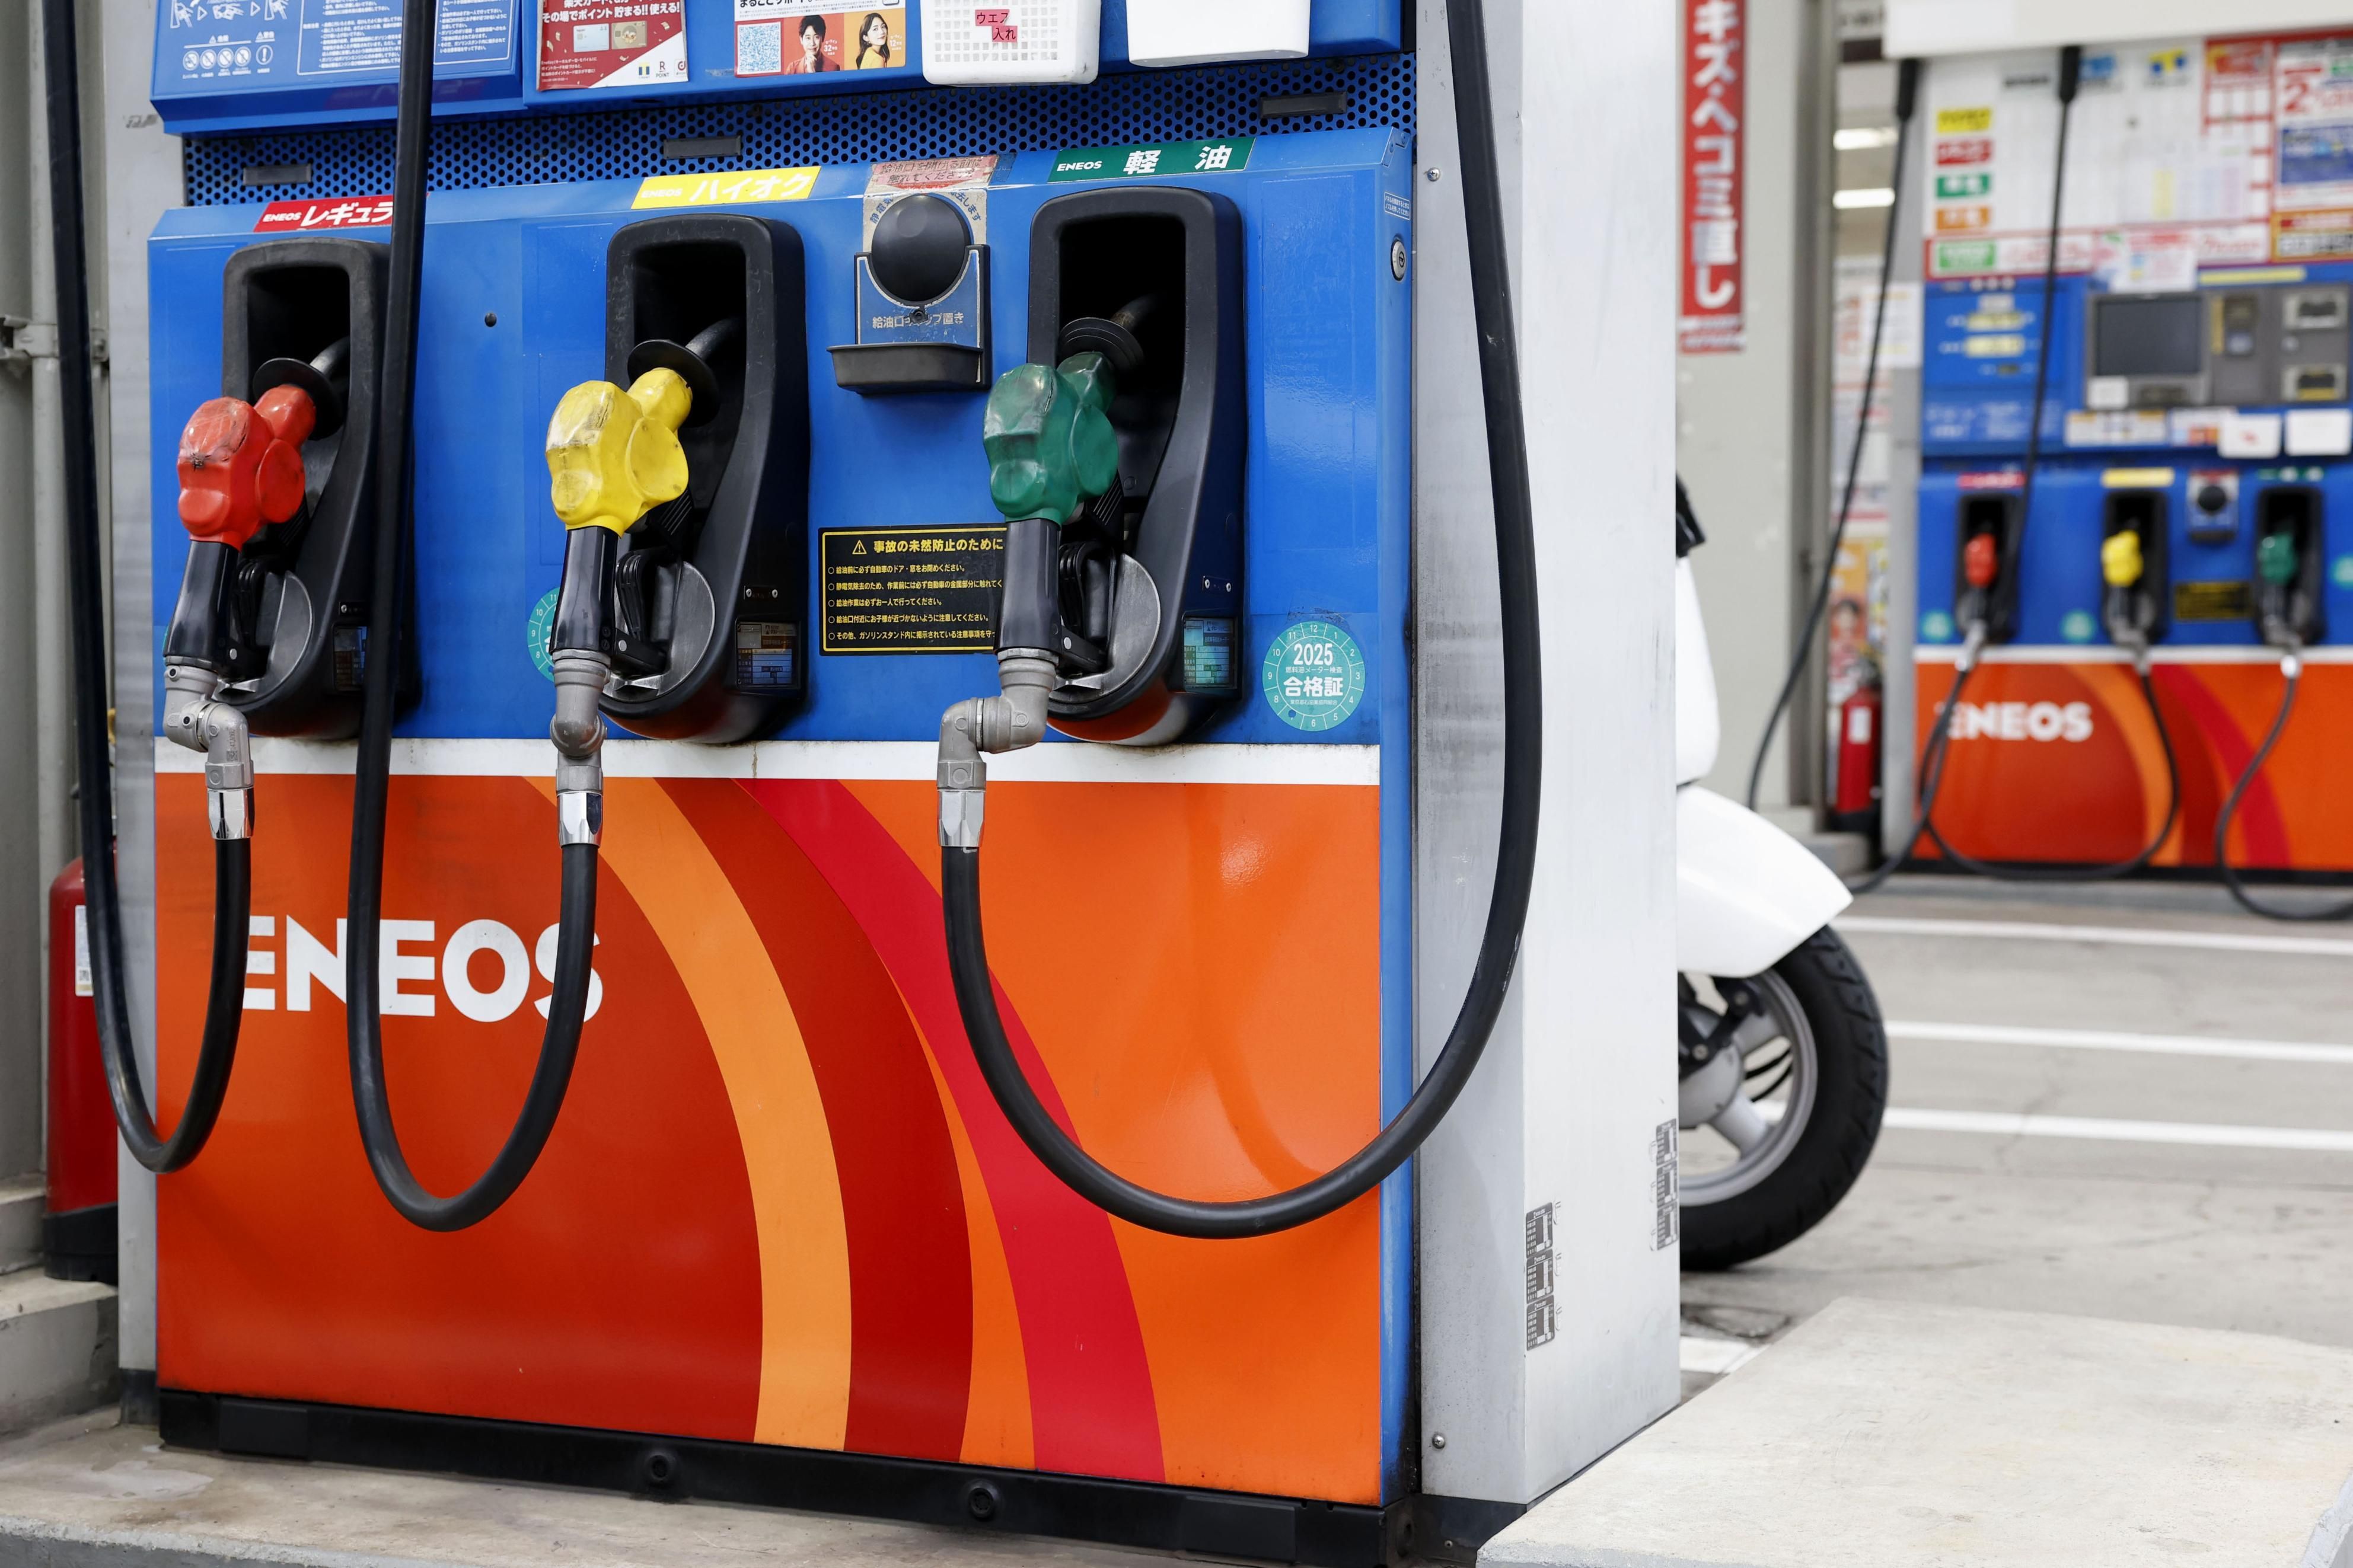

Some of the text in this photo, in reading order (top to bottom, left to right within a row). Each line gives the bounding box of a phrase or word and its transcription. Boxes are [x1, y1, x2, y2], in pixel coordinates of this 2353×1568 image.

[542, 3, 680, 23] その場でポイント 貯まる!! 使える!
[993, 28, 1016, 40] 入れ
[1057, 145, 1233, 175] ENEOS 軽油
[641, 173, 812, 202] ENEOS ハイオク
[263, 202, 394, 227] ENEOS レギュラ
[870, 196, 893, 223] 静電気
[873, 538, 1004, 553] 事故の未然防止のために
[836, 598, 942, 607] 給油作業は必ずお一人で行ってください。
[1309, 624, 1318, 633] 12
[1293, 643, 1333, 666] 2025
[1350, 649, 1355, 657] 2
[1356, 672, 1360, 680] 3
[1283, 676, 1344, 697] 合格証
[1274, 695, 1279, 703] 8
[1348, 695, 1354, 704] 4
[1311, 719, 1316, 727] 6
[1333, 713, 1338, 721] 5
